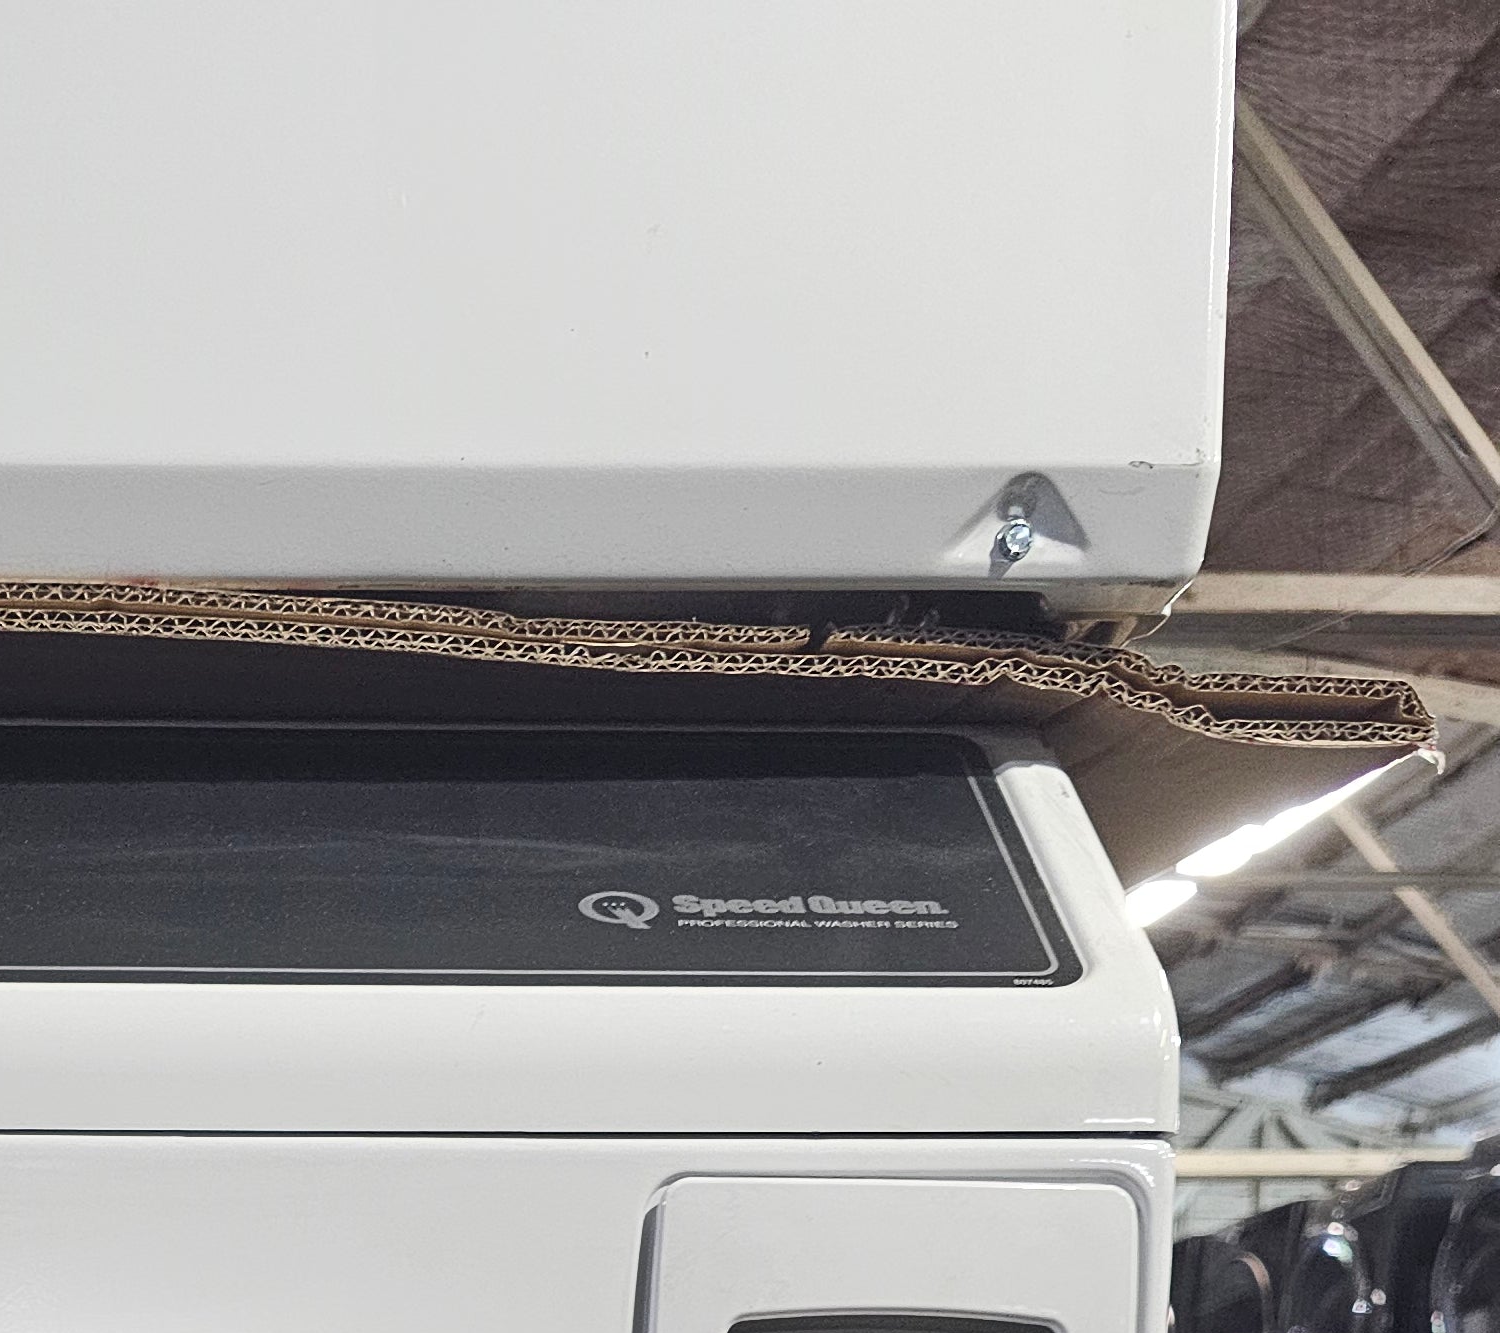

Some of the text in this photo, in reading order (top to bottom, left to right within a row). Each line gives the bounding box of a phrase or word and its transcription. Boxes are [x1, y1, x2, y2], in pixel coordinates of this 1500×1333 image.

[672, 894, 807, 917] Speed
[678, 920, 959, 928] PROFESSIONAL WASHER SERIES
